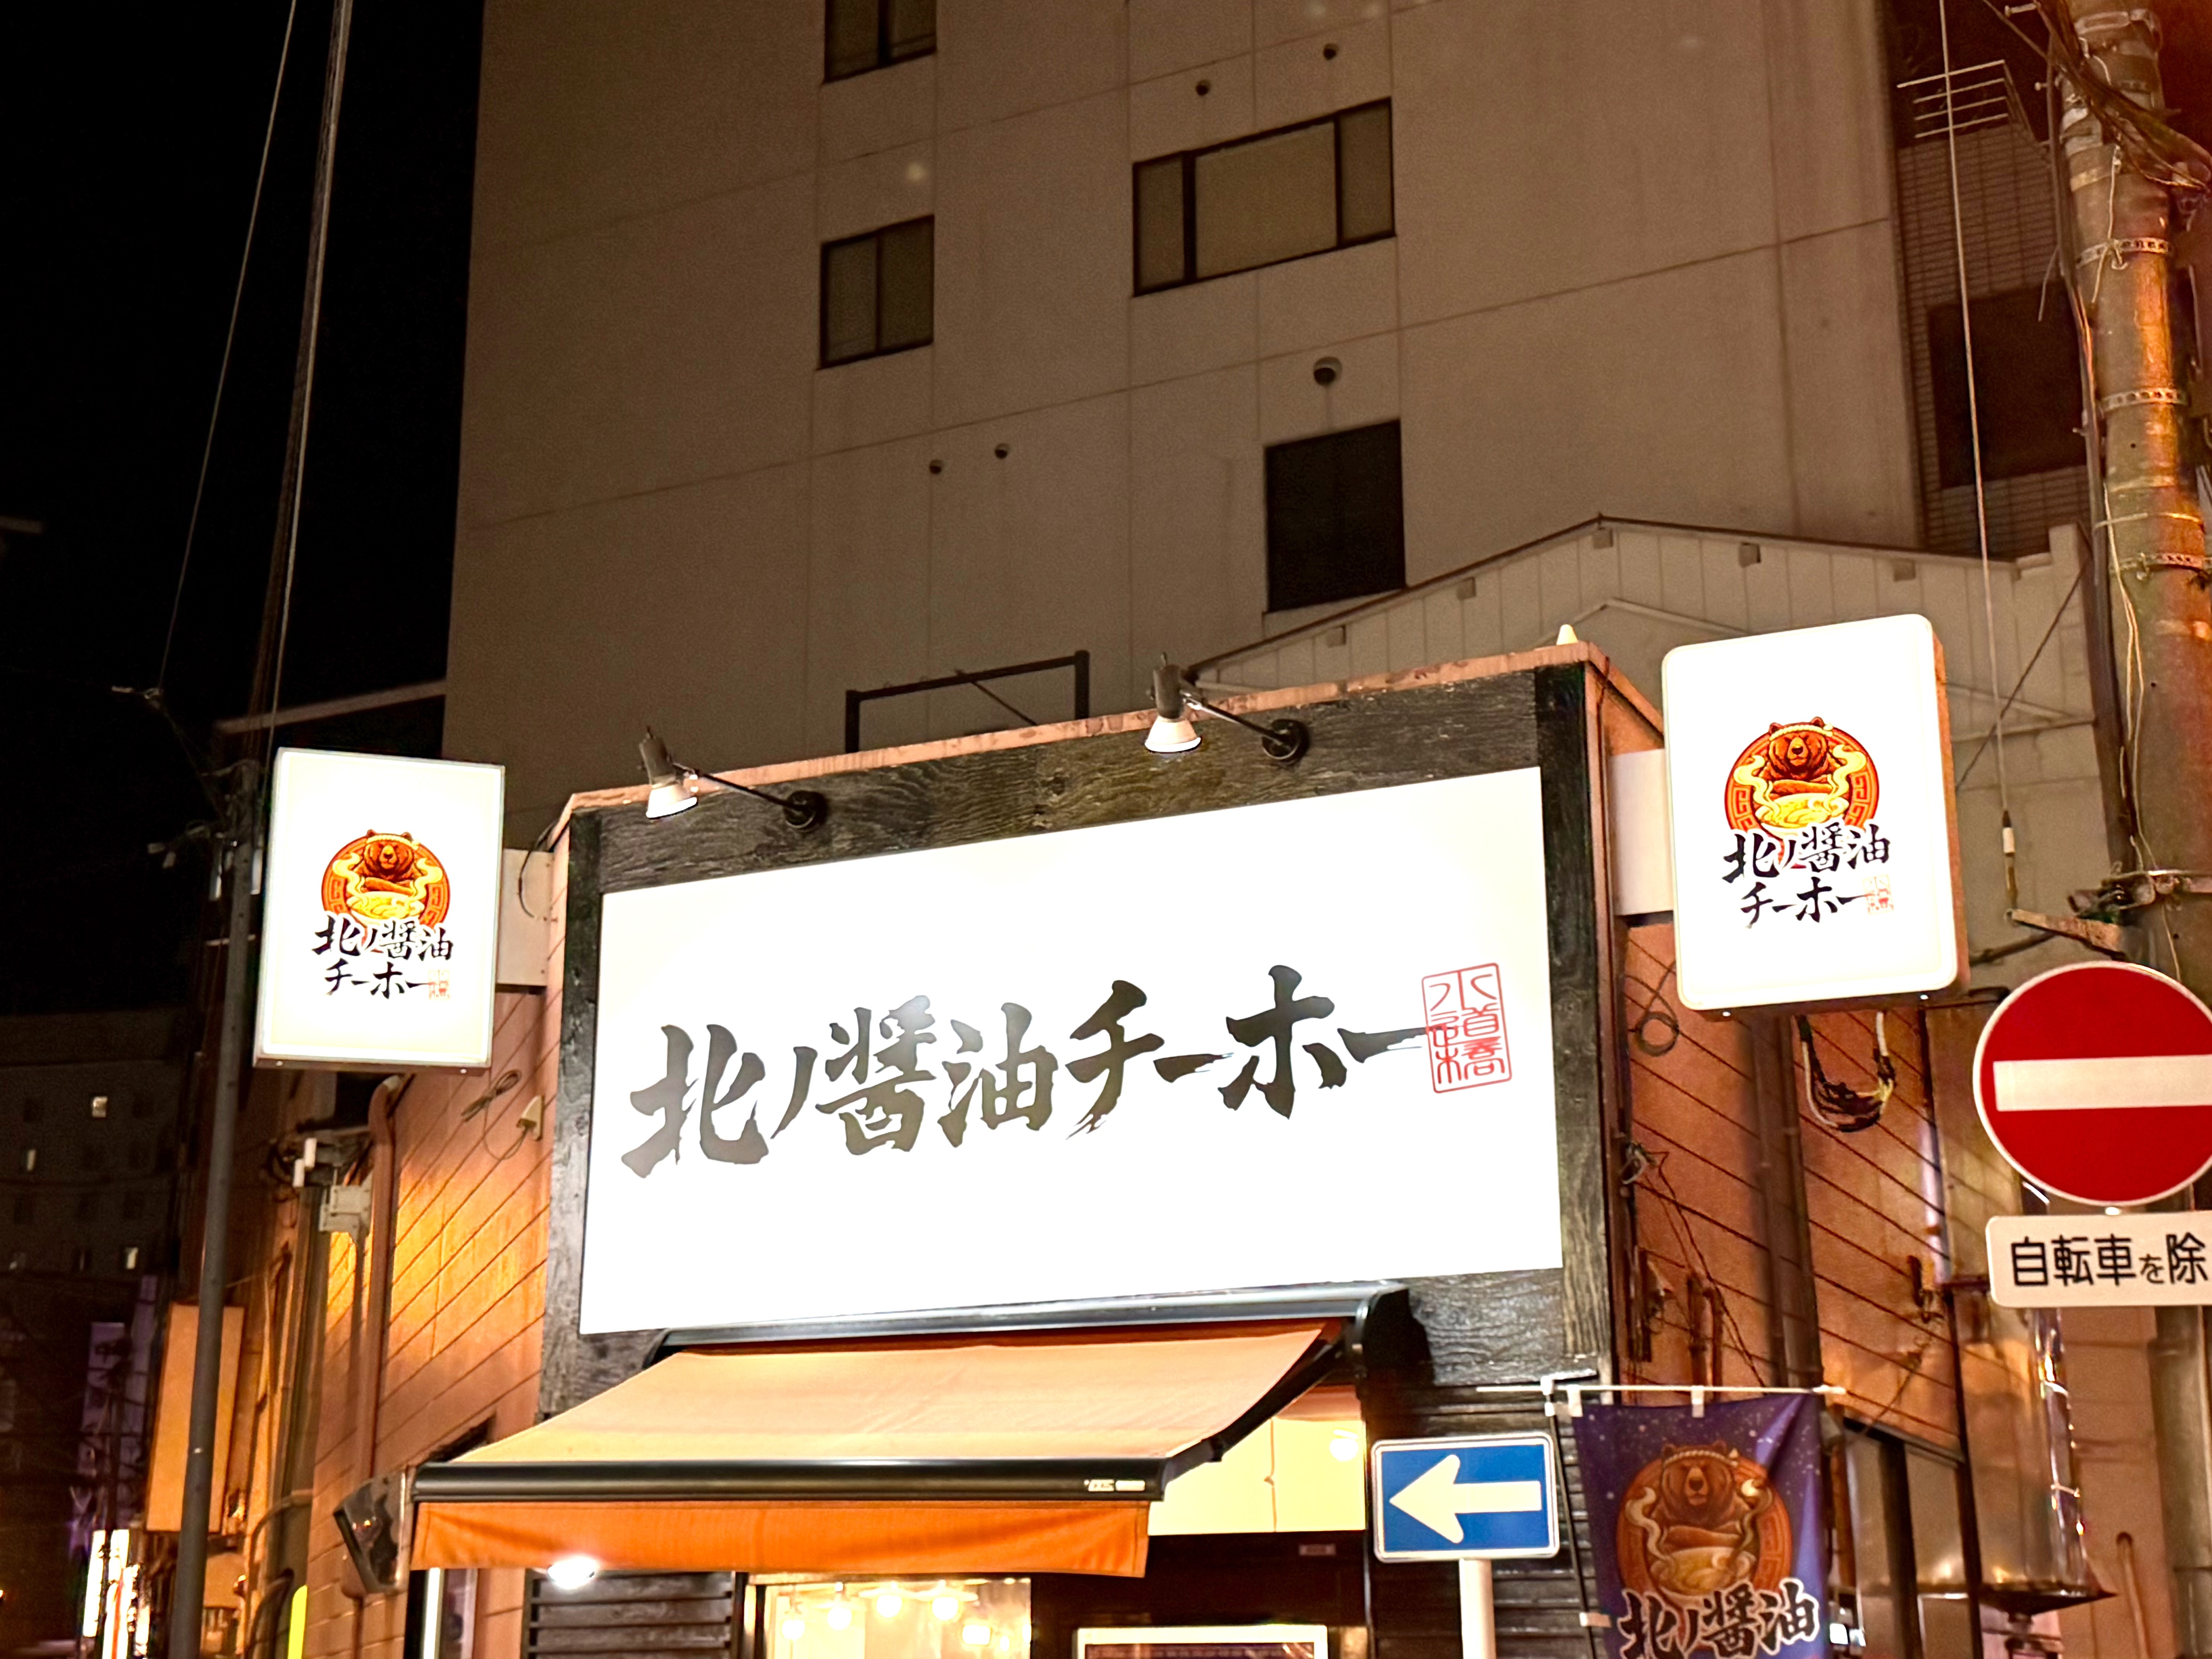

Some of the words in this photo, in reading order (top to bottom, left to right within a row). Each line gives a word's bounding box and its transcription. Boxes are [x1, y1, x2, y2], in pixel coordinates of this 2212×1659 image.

[1722, 822, 1891, 883] 北ノ醤油
[312, 915, 454, 961] 北ノ醤油
